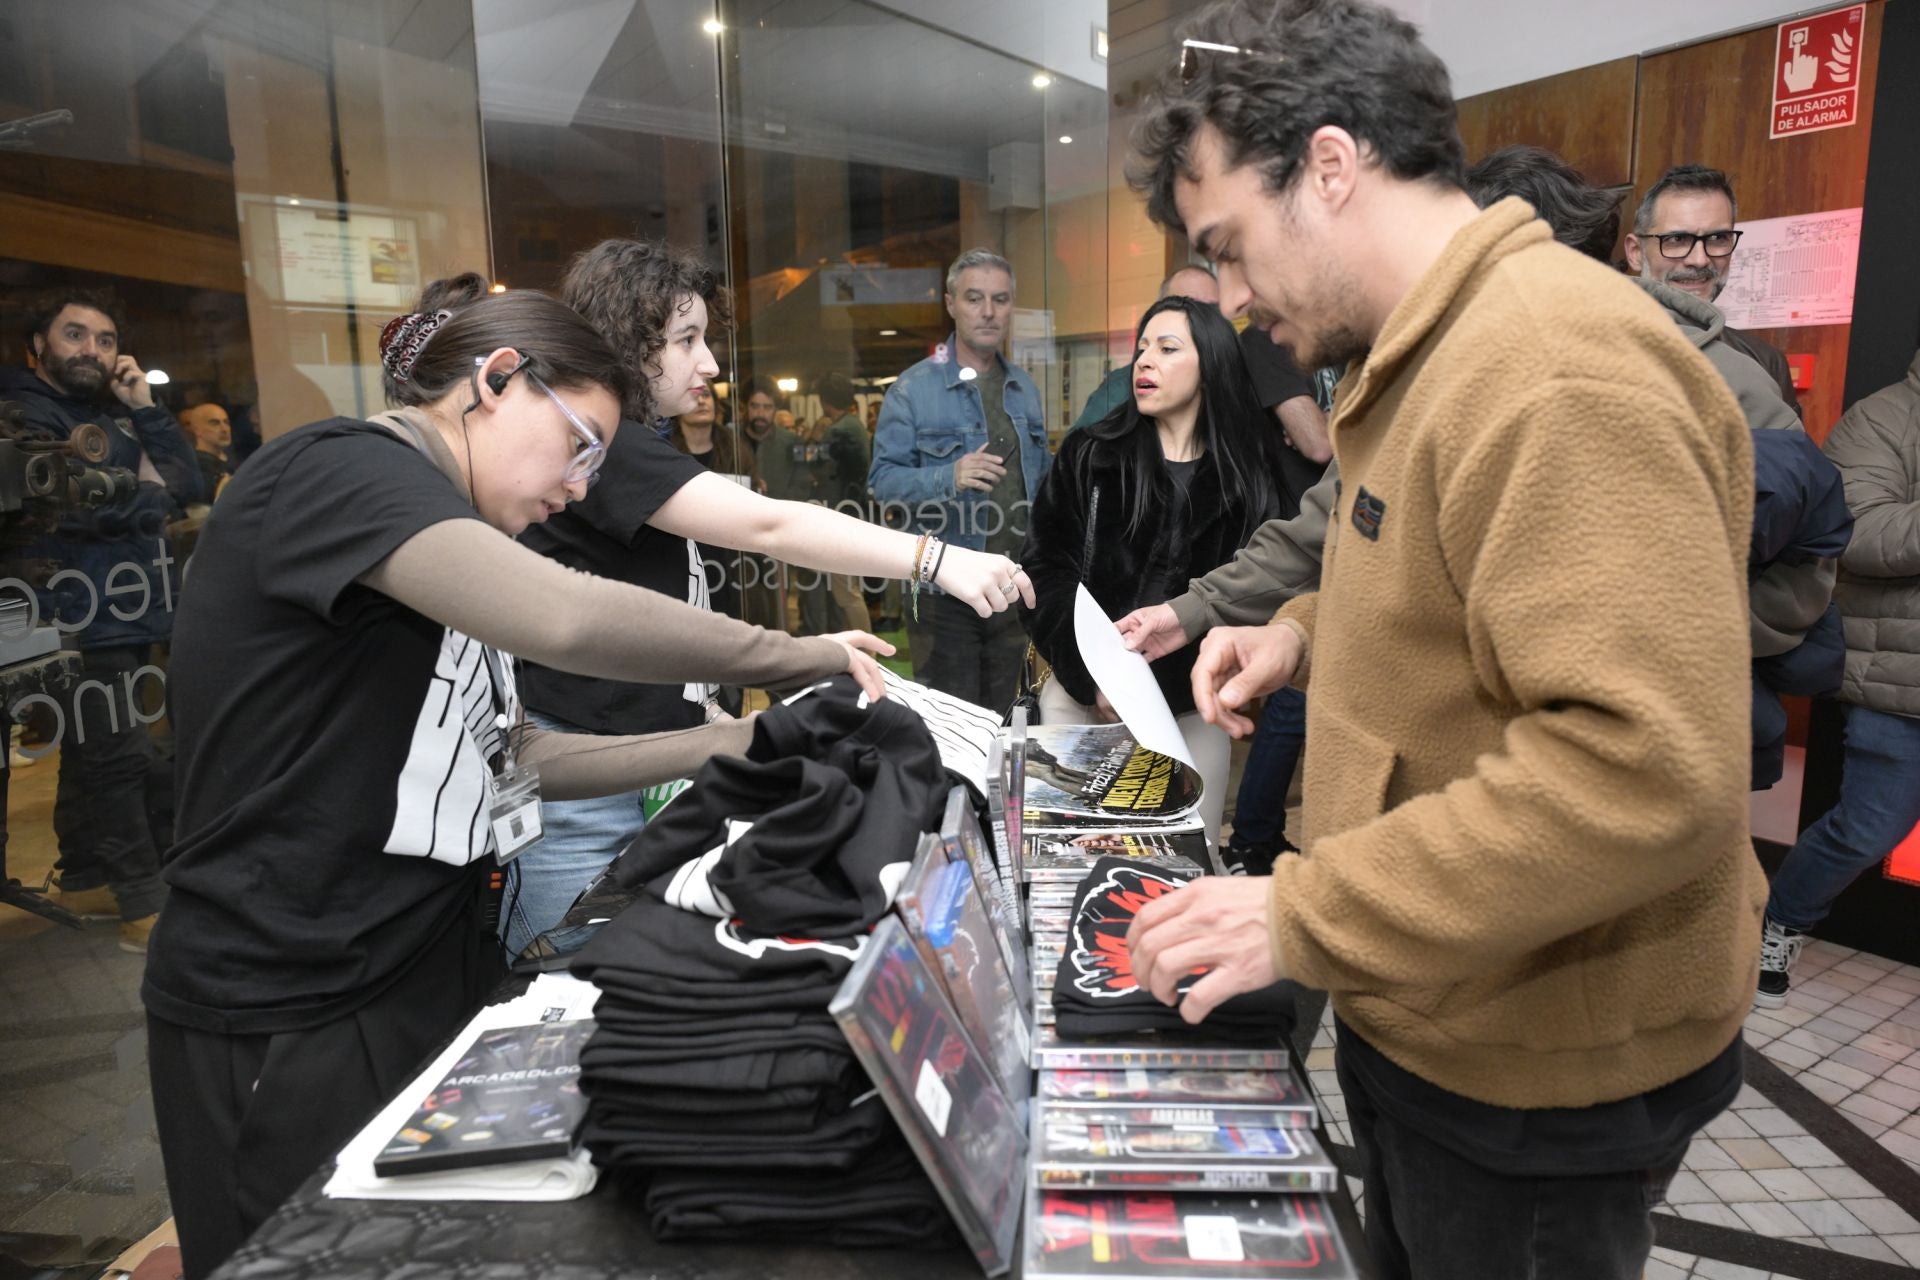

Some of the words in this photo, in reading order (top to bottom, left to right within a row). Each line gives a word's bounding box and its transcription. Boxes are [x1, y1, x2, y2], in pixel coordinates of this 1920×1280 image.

[1781, 95, 1847, 117] PULSADOR
[1777, 119, 1794, 131] DE
[1796, 109, 1848, 128] ALARMA
[1100, 777, 1146, 808] NUEVA
[444, 1065, 583, 1086] ARCADEOLOG
[1203, 1172, 1271, 1188] JUSTICIA
